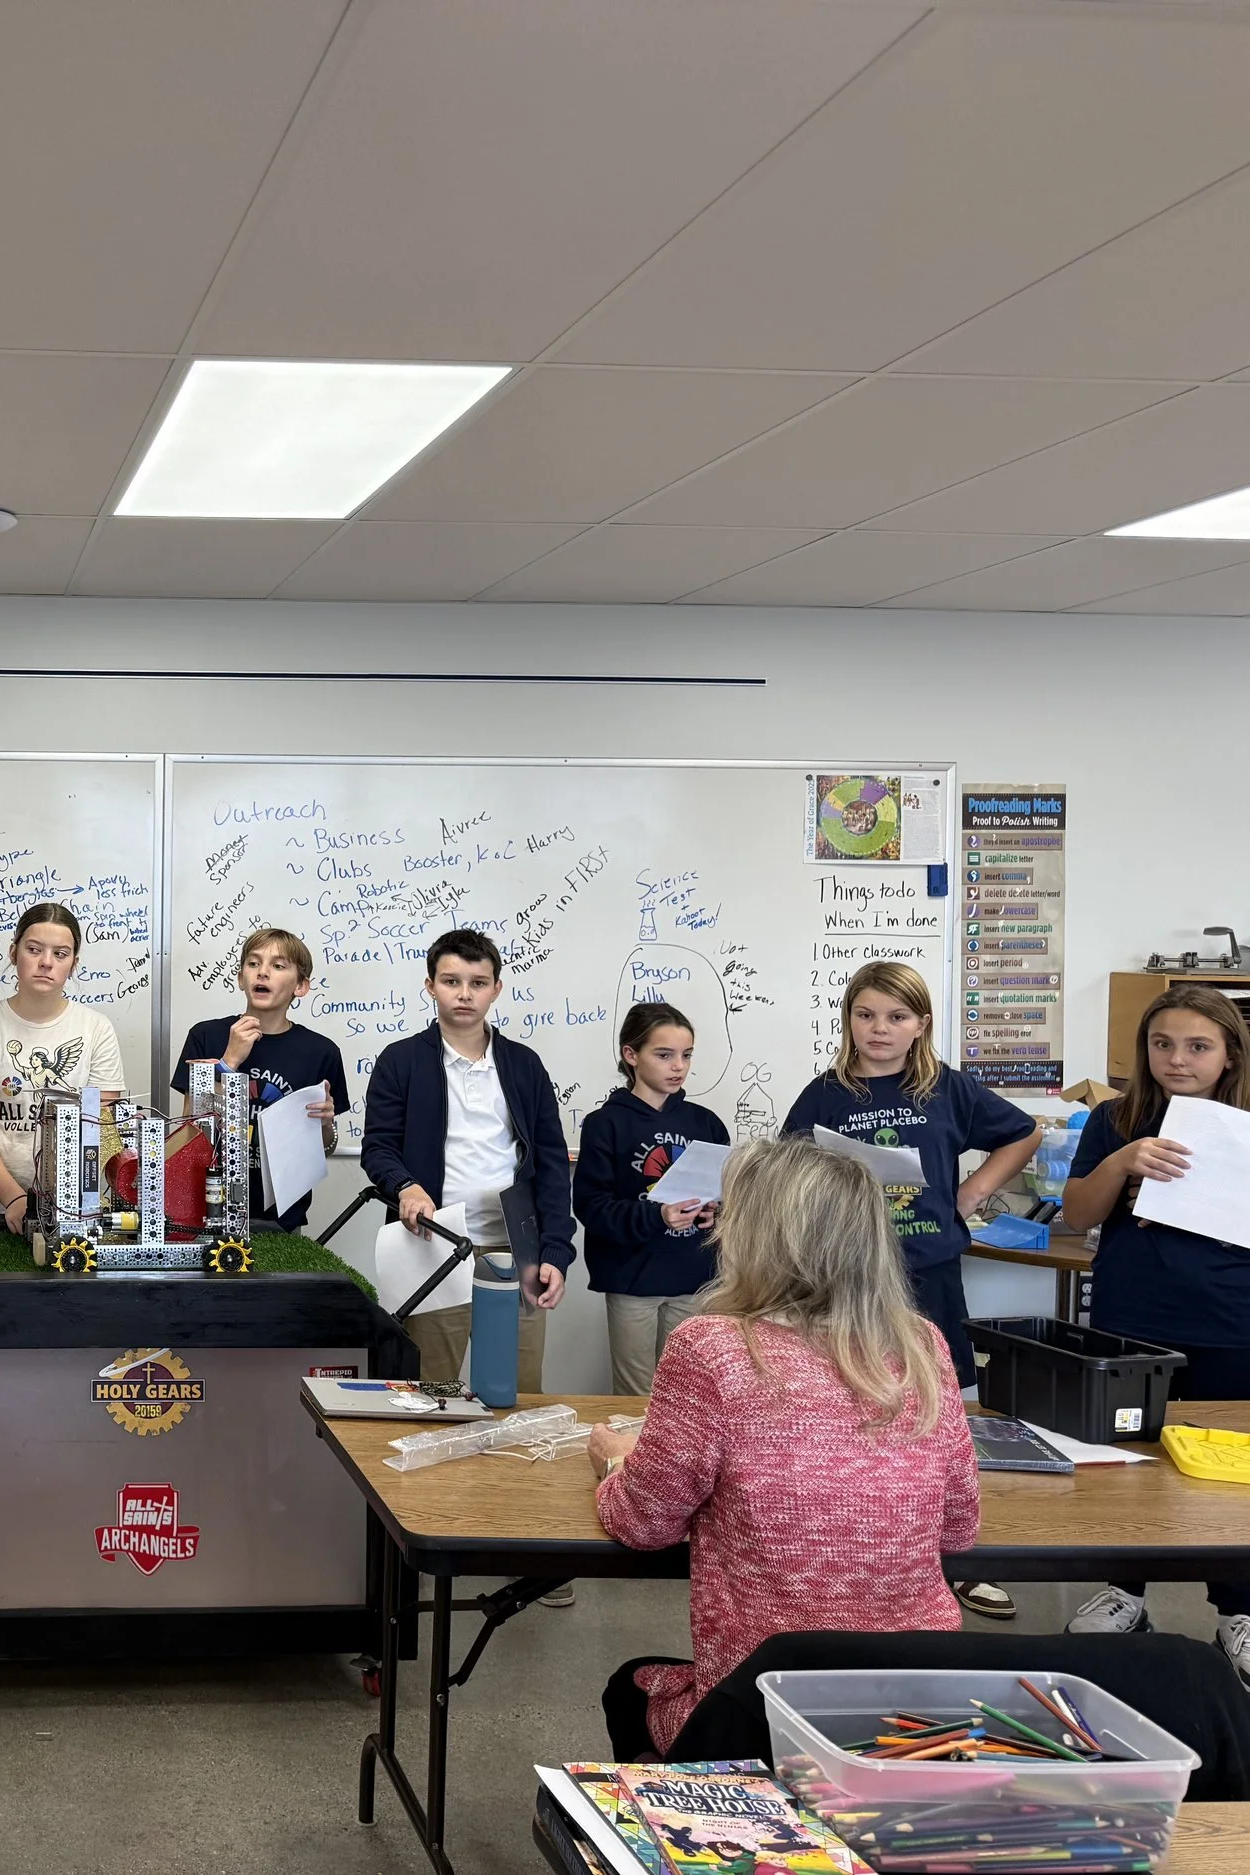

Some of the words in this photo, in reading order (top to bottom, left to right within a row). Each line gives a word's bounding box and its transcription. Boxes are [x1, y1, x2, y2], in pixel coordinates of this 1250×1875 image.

[213, 799, 327, 826] Outreach
[968, 797, 1031, 815] Proofreading
[1033, 797, 1062, 813] Marks
[972, 816, 991, 826] Proof
[993, 816, 1000, 826] to
[1001, 816, 1031, 826] Polish
[1032, 816, 1058, 827] Writing
[314, 828, 406, 854] Business
[317, 858, 372, 881] Clubs
[525, 826, 576, 853] Harry
[984, 852, 1018, 864] capitalize
[636, 868, 700, 899] Science
[984, 886, 1007, 898] delete
[556, 894, 573, 912] in
[659, 887, 696, 906] Test
[813, 875, 874, 912] Things
[210, 881, 255, 938] engineers
[317, 890, 369, 918] Camp
[516, 894, 548, 934] grow
[825, 911, 864, 929] When
[873, 910, 899, 928] I'm
[906, 908, 938, 928] done
[368, 915, 430, 939] Soccer
[1017, 922, 1053, 934] paragraph
[323, 946, 382, 964] Parade
[630, 961, 691, 984] Bryson
[1000, 975, 1030, 986] question
[311, 990, 406, 1018] Community
[512, 986, 535, 1002] us
[1000, 993, 1034, 1004] quotation
[377, 1018, 409, 1033] we
[565, 998, 607, 1026] back
[1024, 1010, 1043, 1021] space
[992, 1028, 1019, 1039] spelling
[0, 1101, 24, 1121] ALL
[848, 1109, 895, 1123] MISSION
[897, 1108, 912, 1117] TO
[838, 1119, 878, 1134] PLANET
[880, 1115, 927, 1128] PLACEBO
[885, 1184, 920, 1194] GEARS
[96, 1384, 141, 1399] HOLY
[145, 1384, 202, 1399] GEARS
[134, 1404, 162, 1418] 20159
[125, 1499, 156, 1511] ALL
[100, 1528, 194, 1559] ARCHANGELS
[664, 1780, 746, 1800] MAGIC
[644, 1791, 707, 1812] TREE
[710, 1799, 787, 1816] HOUSE
